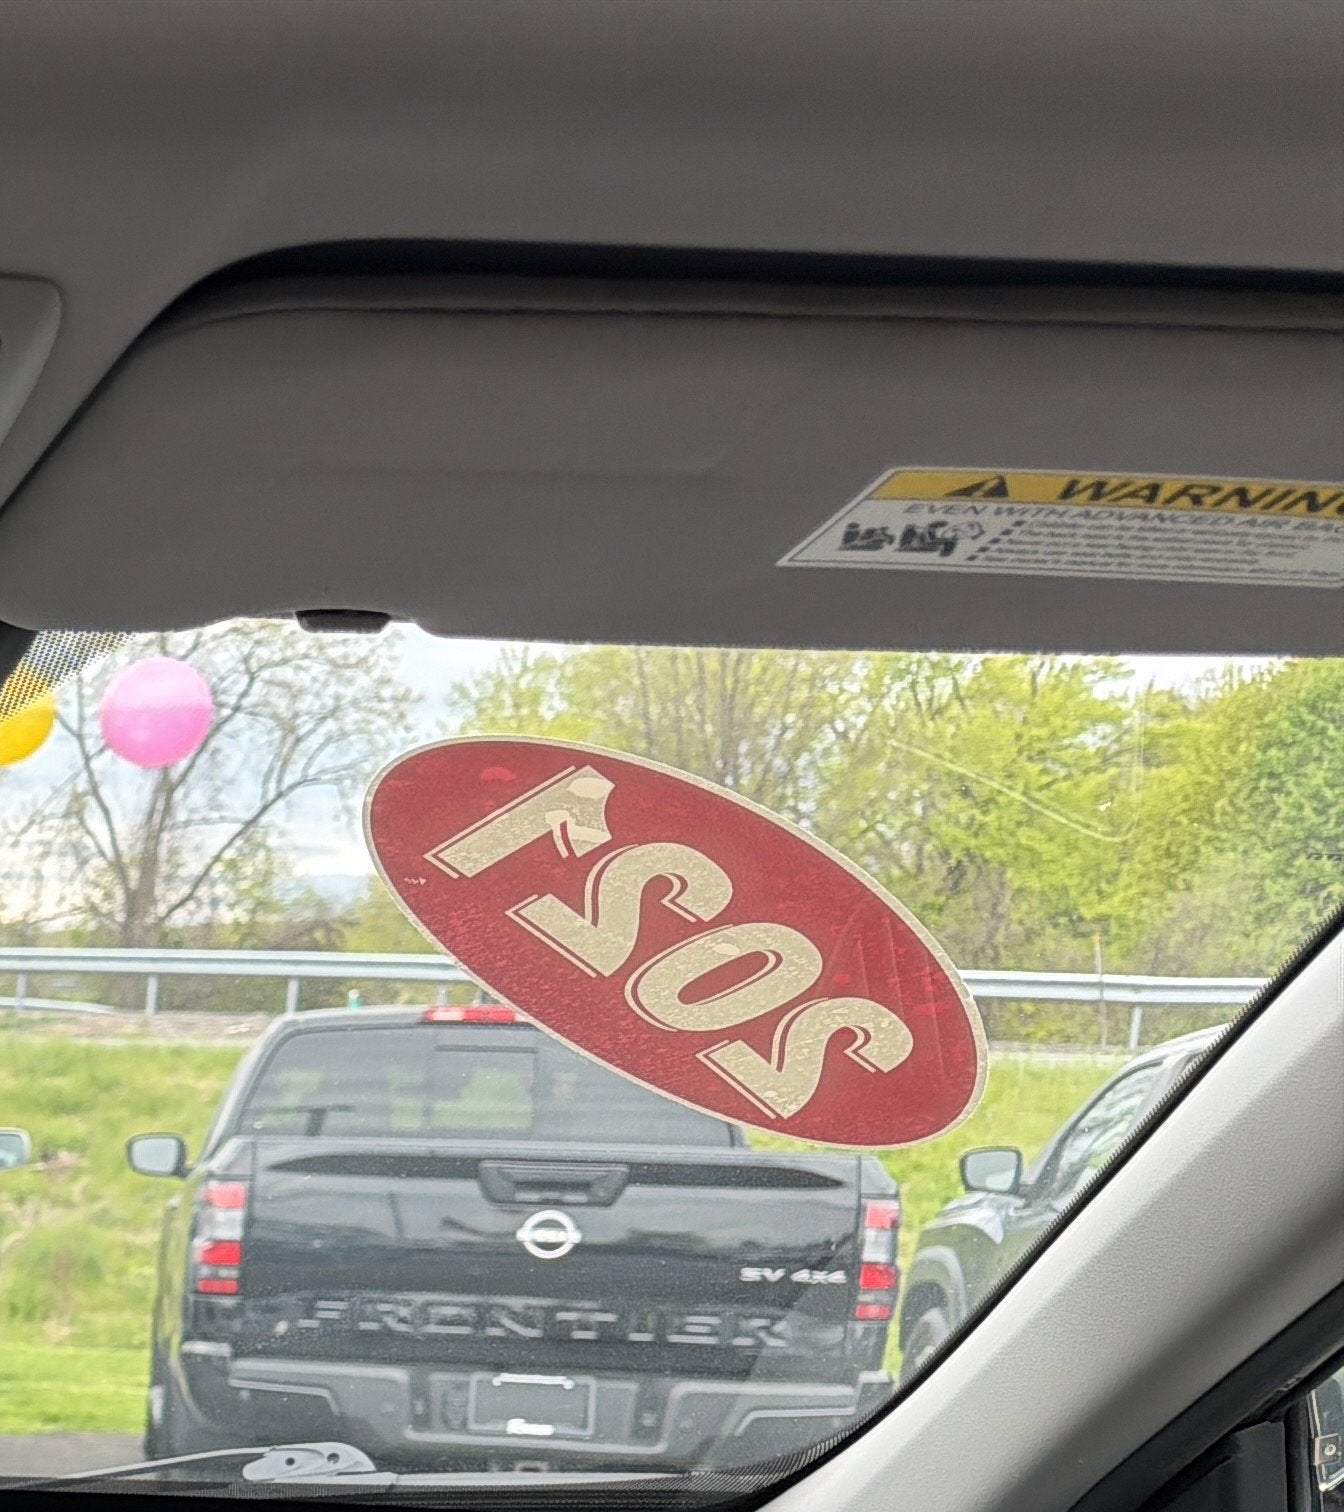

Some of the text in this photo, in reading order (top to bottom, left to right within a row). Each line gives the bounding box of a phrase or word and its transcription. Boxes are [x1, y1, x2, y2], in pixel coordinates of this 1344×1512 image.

[1057, 478, 1344, 515] WARNIN
[903, 504, 988, 515] EVEN
[993, 506, 1068, 518] WITH
[1069, 508, 1235, 526] ADVANCED
[1236, 517, 1292, 529] AIR
[297, 1299, 790, 1348] FRONTIER
